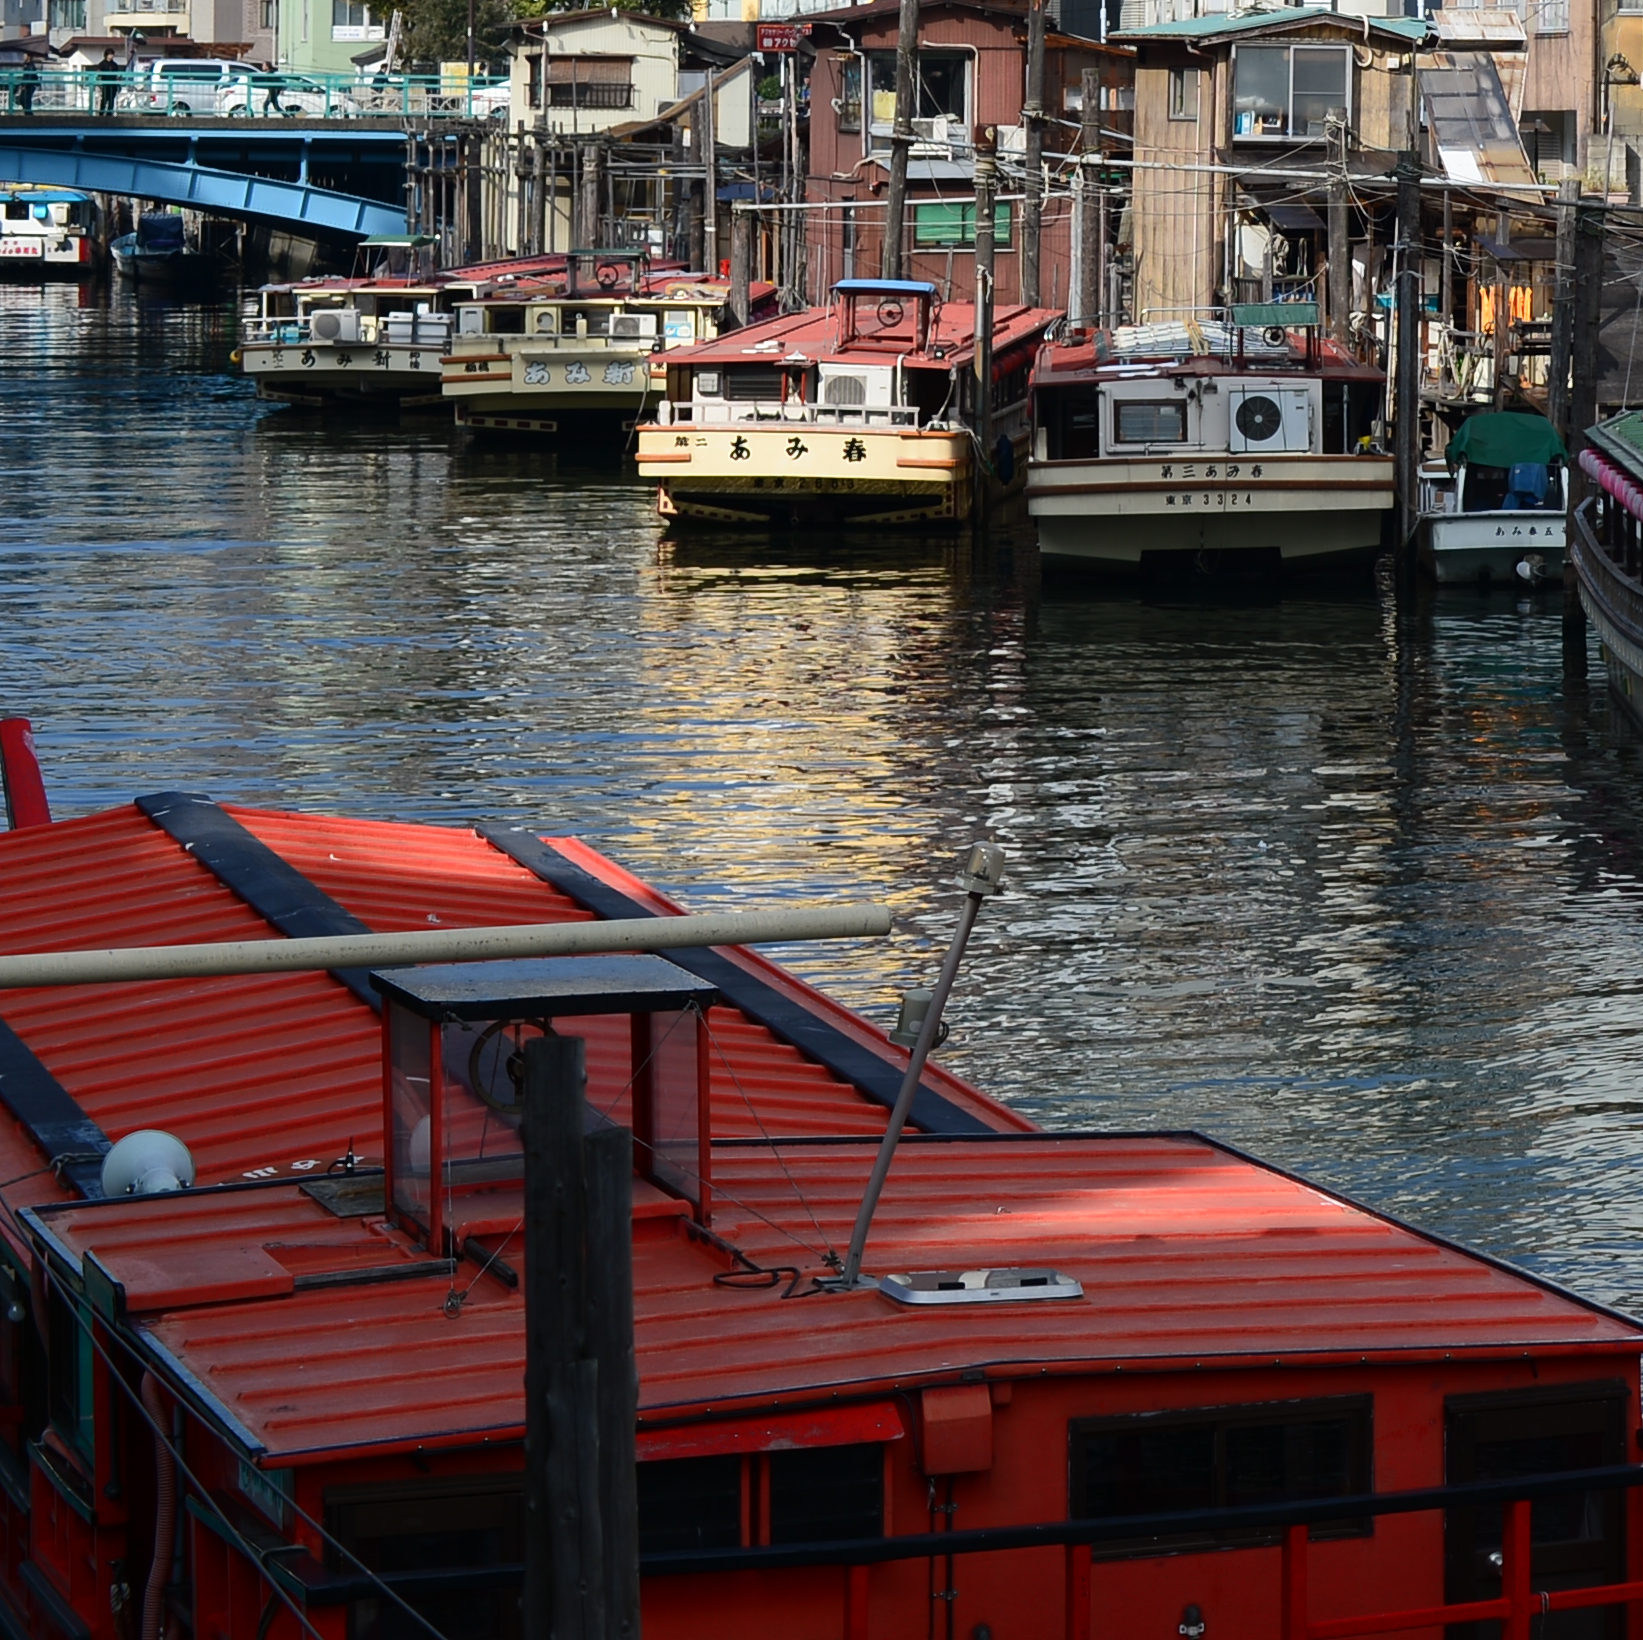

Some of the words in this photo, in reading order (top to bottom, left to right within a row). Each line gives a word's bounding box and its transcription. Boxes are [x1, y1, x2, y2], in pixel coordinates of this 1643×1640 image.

[301, 349, 392, 369] あみ新
[523, 361, 636, 385] あみ新
[674, 436, 708, 448] 第二
[729, 435, 867, 463] あみ春
[1161, 464, 1263, 479] 第三あみ春
